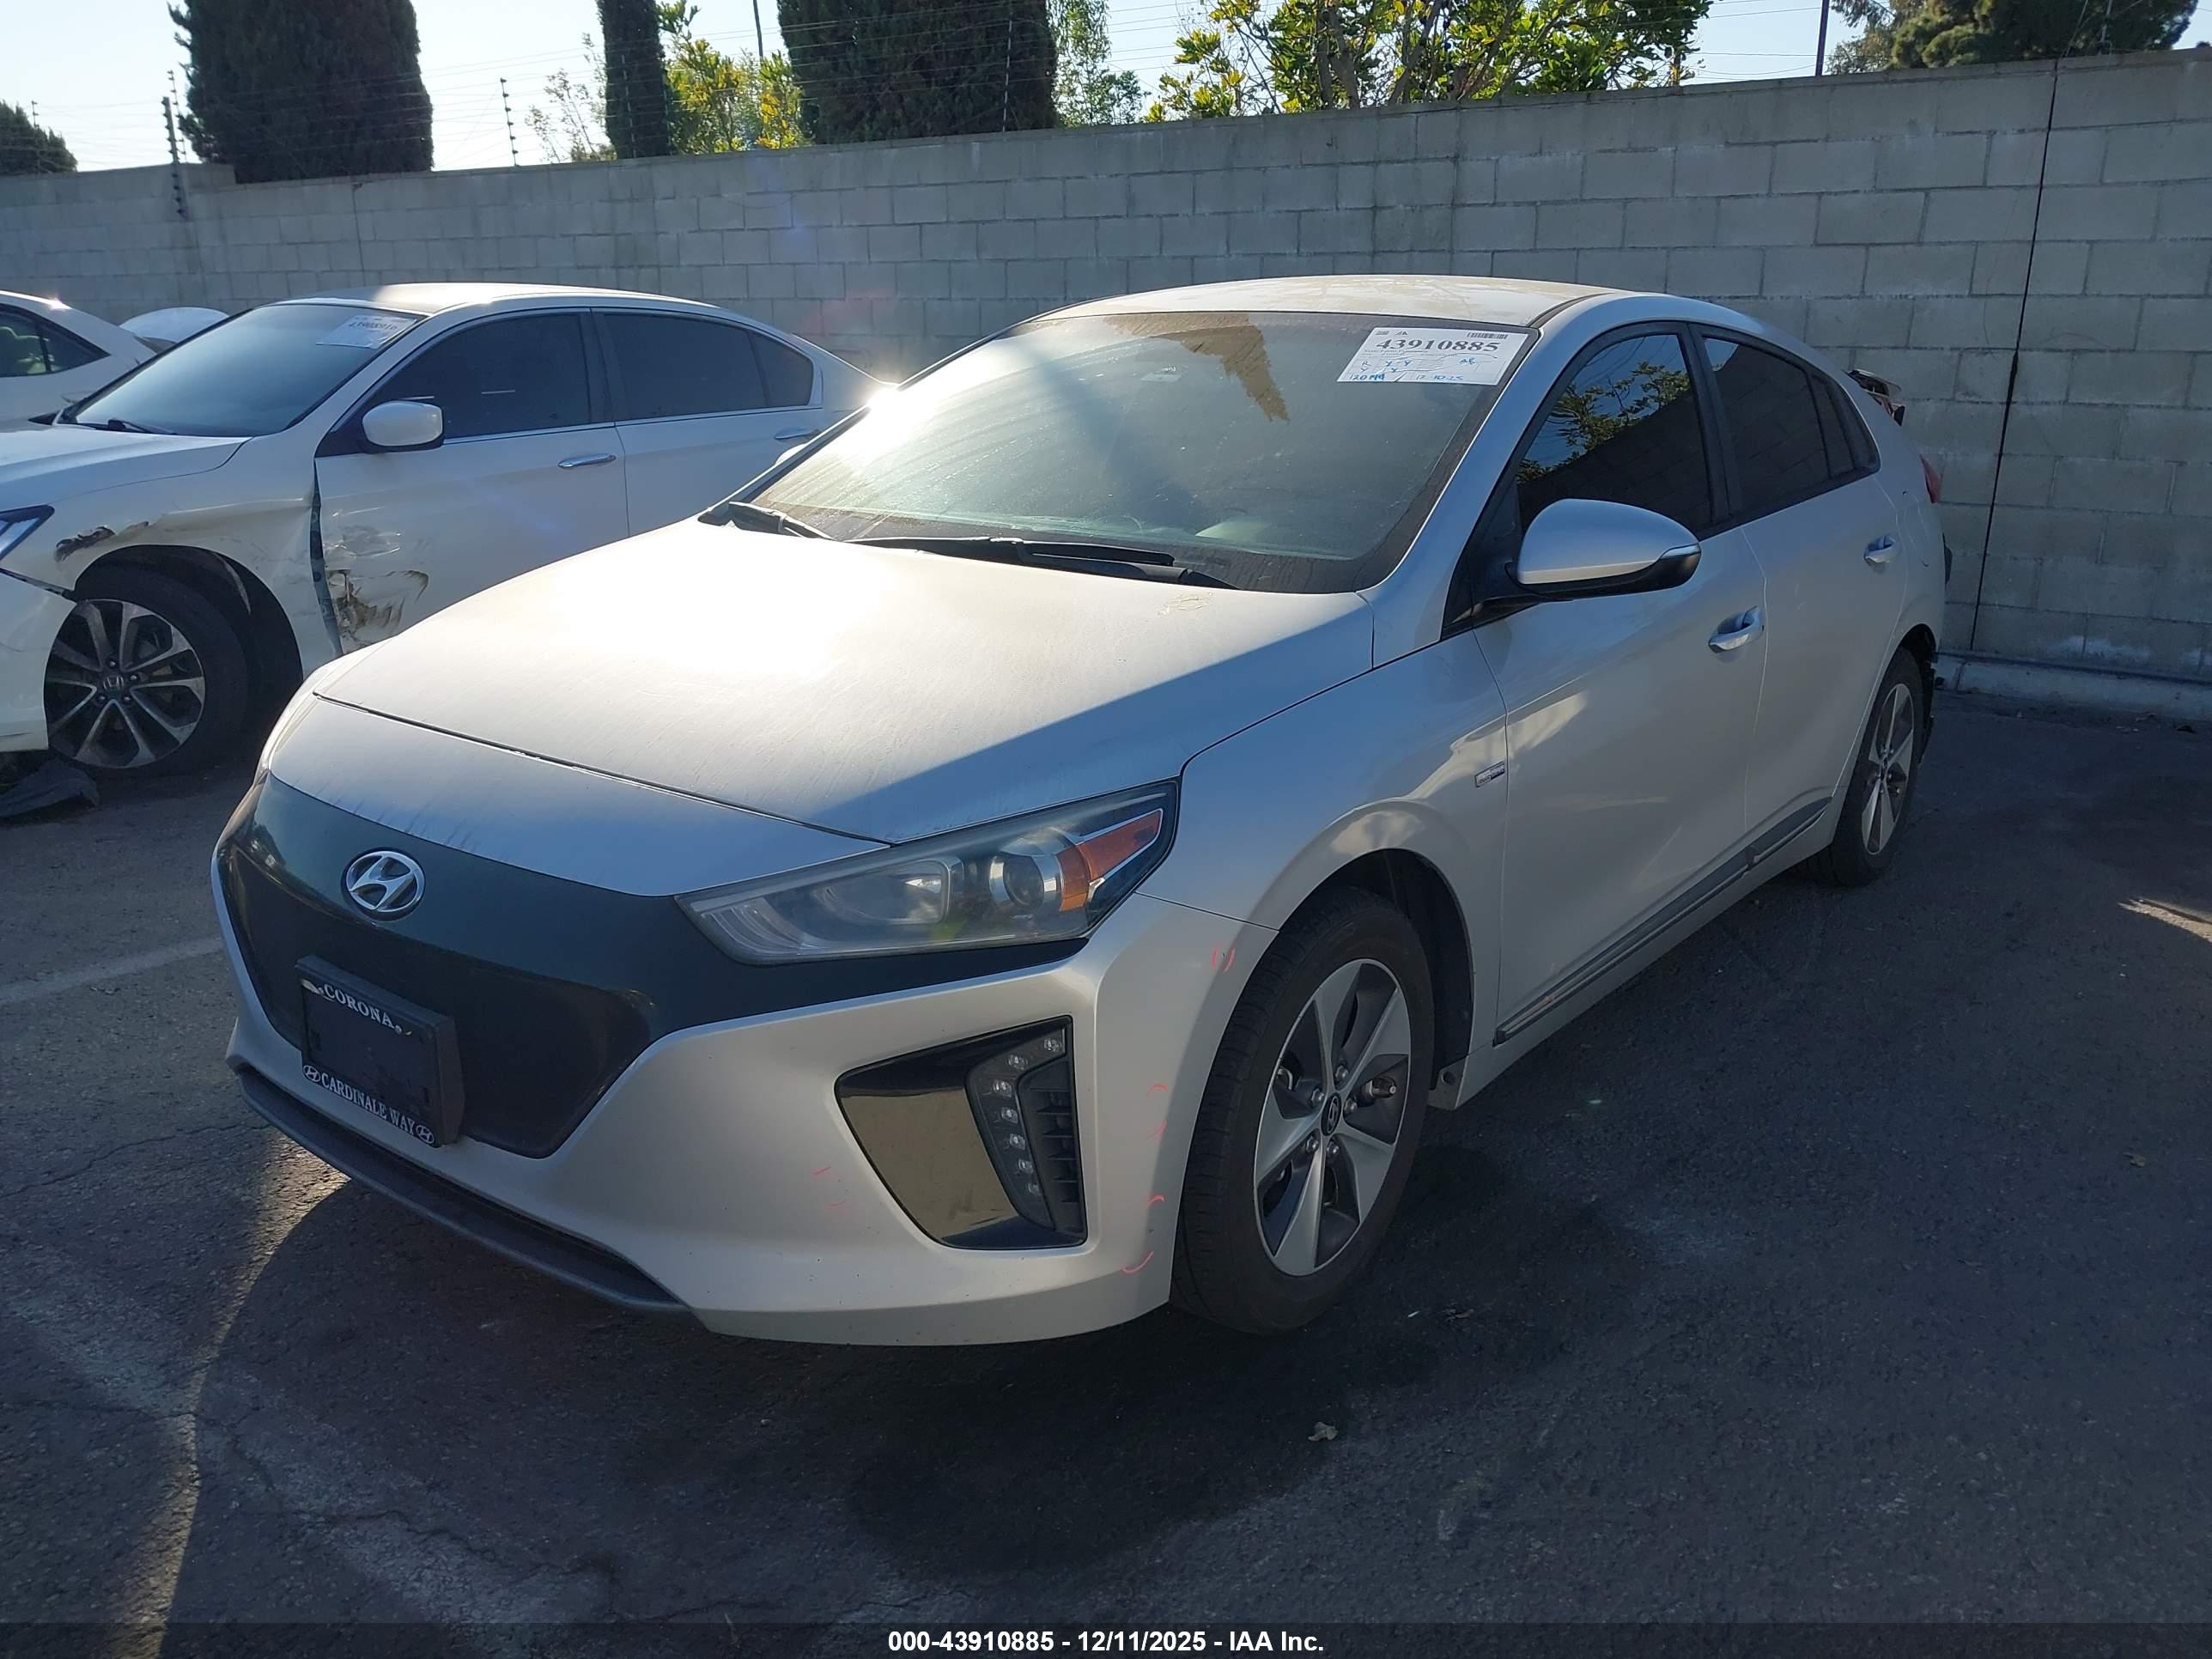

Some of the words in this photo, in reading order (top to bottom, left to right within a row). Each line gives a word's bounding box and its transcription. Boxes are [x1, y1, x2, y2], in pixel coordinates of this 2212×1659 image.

[1376, 338, 1500, 352] 43910885
[323, 983, 395, 1030] CORONA
[321, 1073, 387, 1121] CARDINALE
[390, 1107, 416, 1135] WAY
